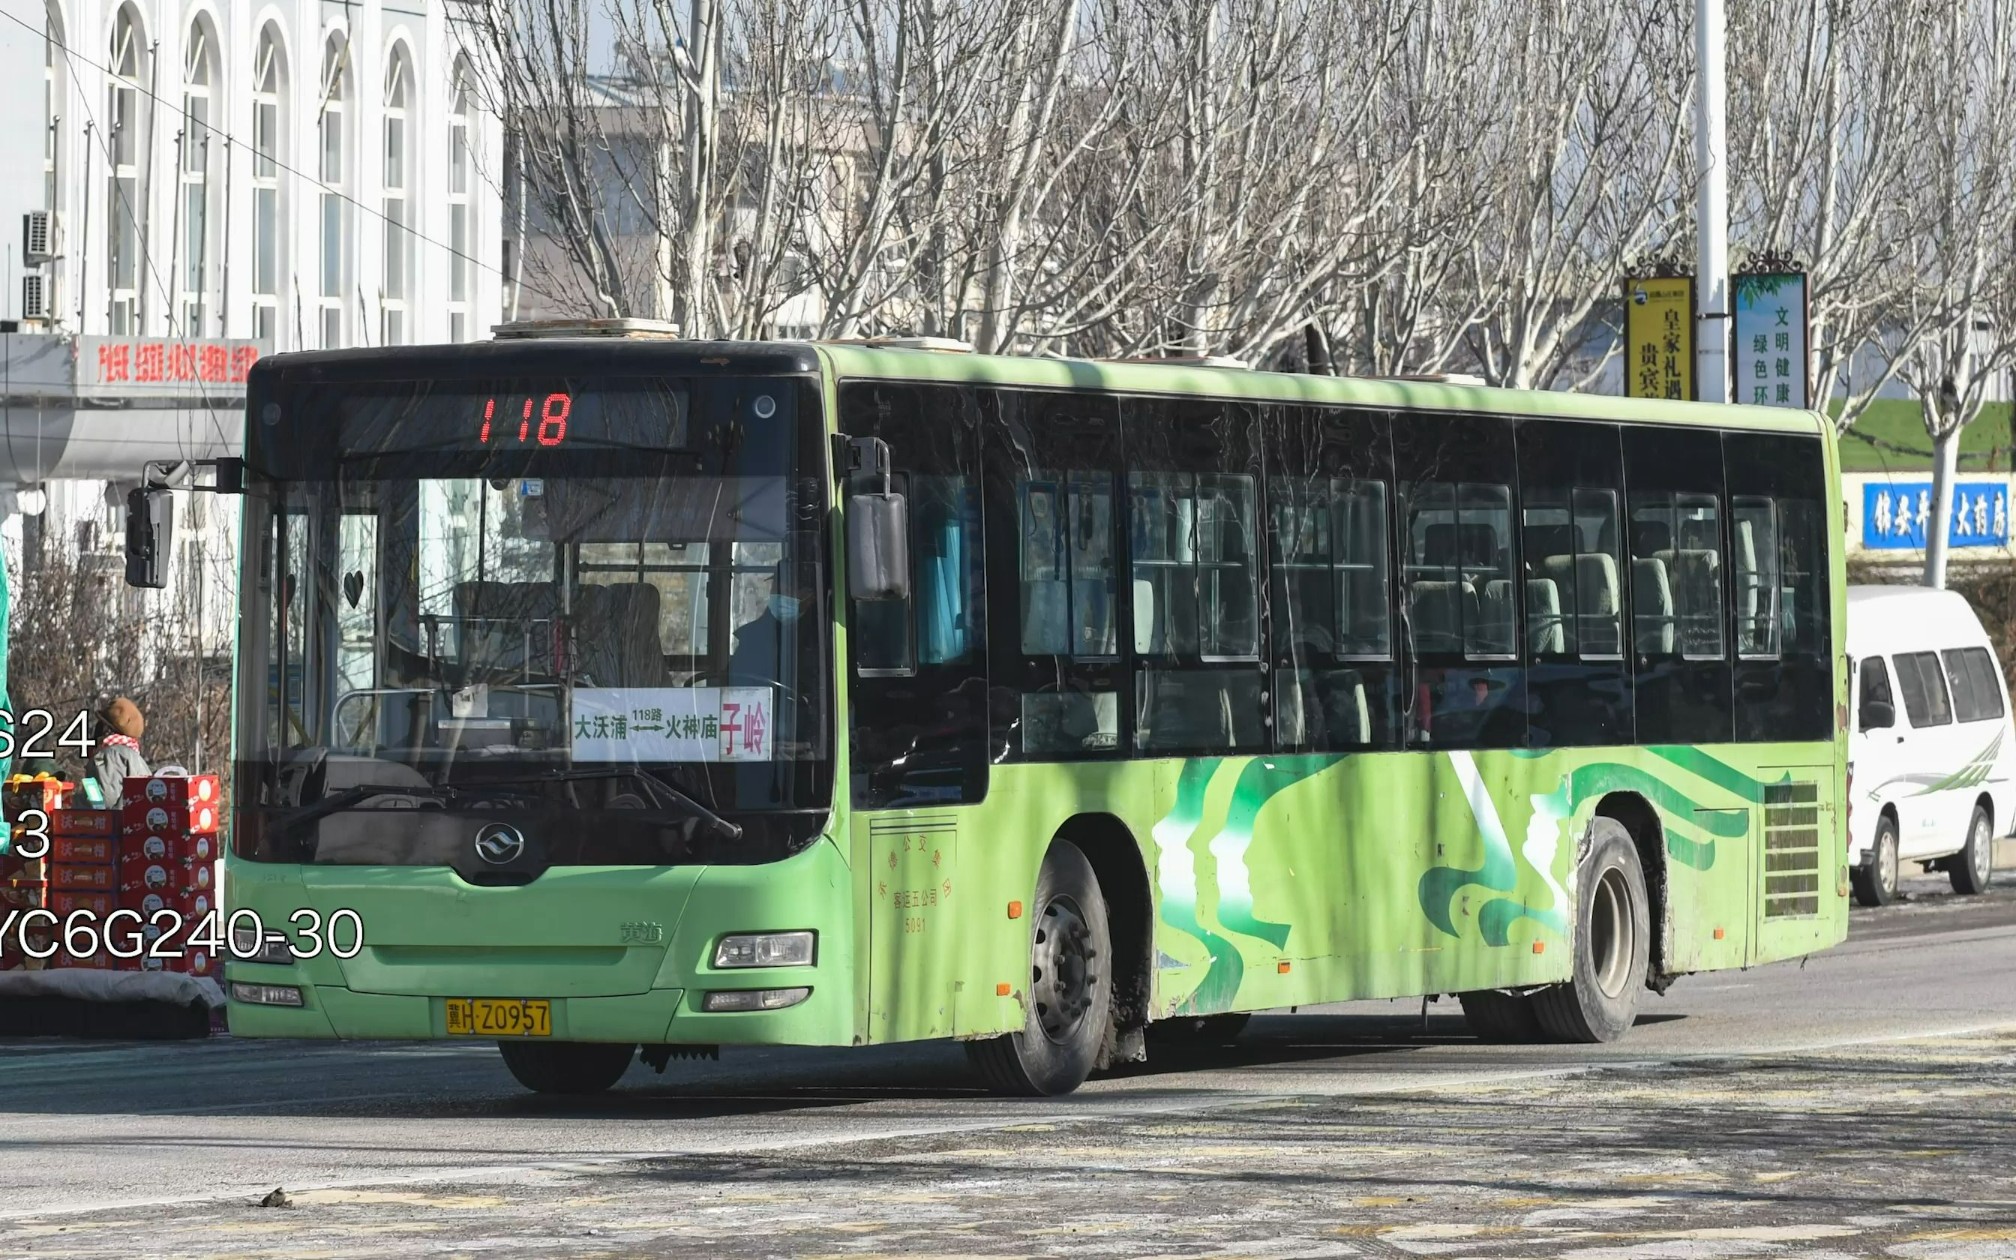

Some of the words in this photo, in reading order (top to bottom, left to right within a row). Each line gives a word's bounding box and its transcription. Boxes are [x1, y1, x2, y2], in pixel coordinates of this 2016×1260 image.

[1663, 308, 1682, 400] 皇家礼遇
[1753, 334, 1768, 406] 绿色环
[1775, 305, 1790, 403] 文明健康
[480, 393, 571, 446] 118
[574, 714, 627, 740] 大沃浦
[665, 714, 718, 740] 火神庙
[720, 701, 766, 757] 子岭
[632, 709, 663, 722] 118路
[894, 888, 937, 909] 客运五公司
